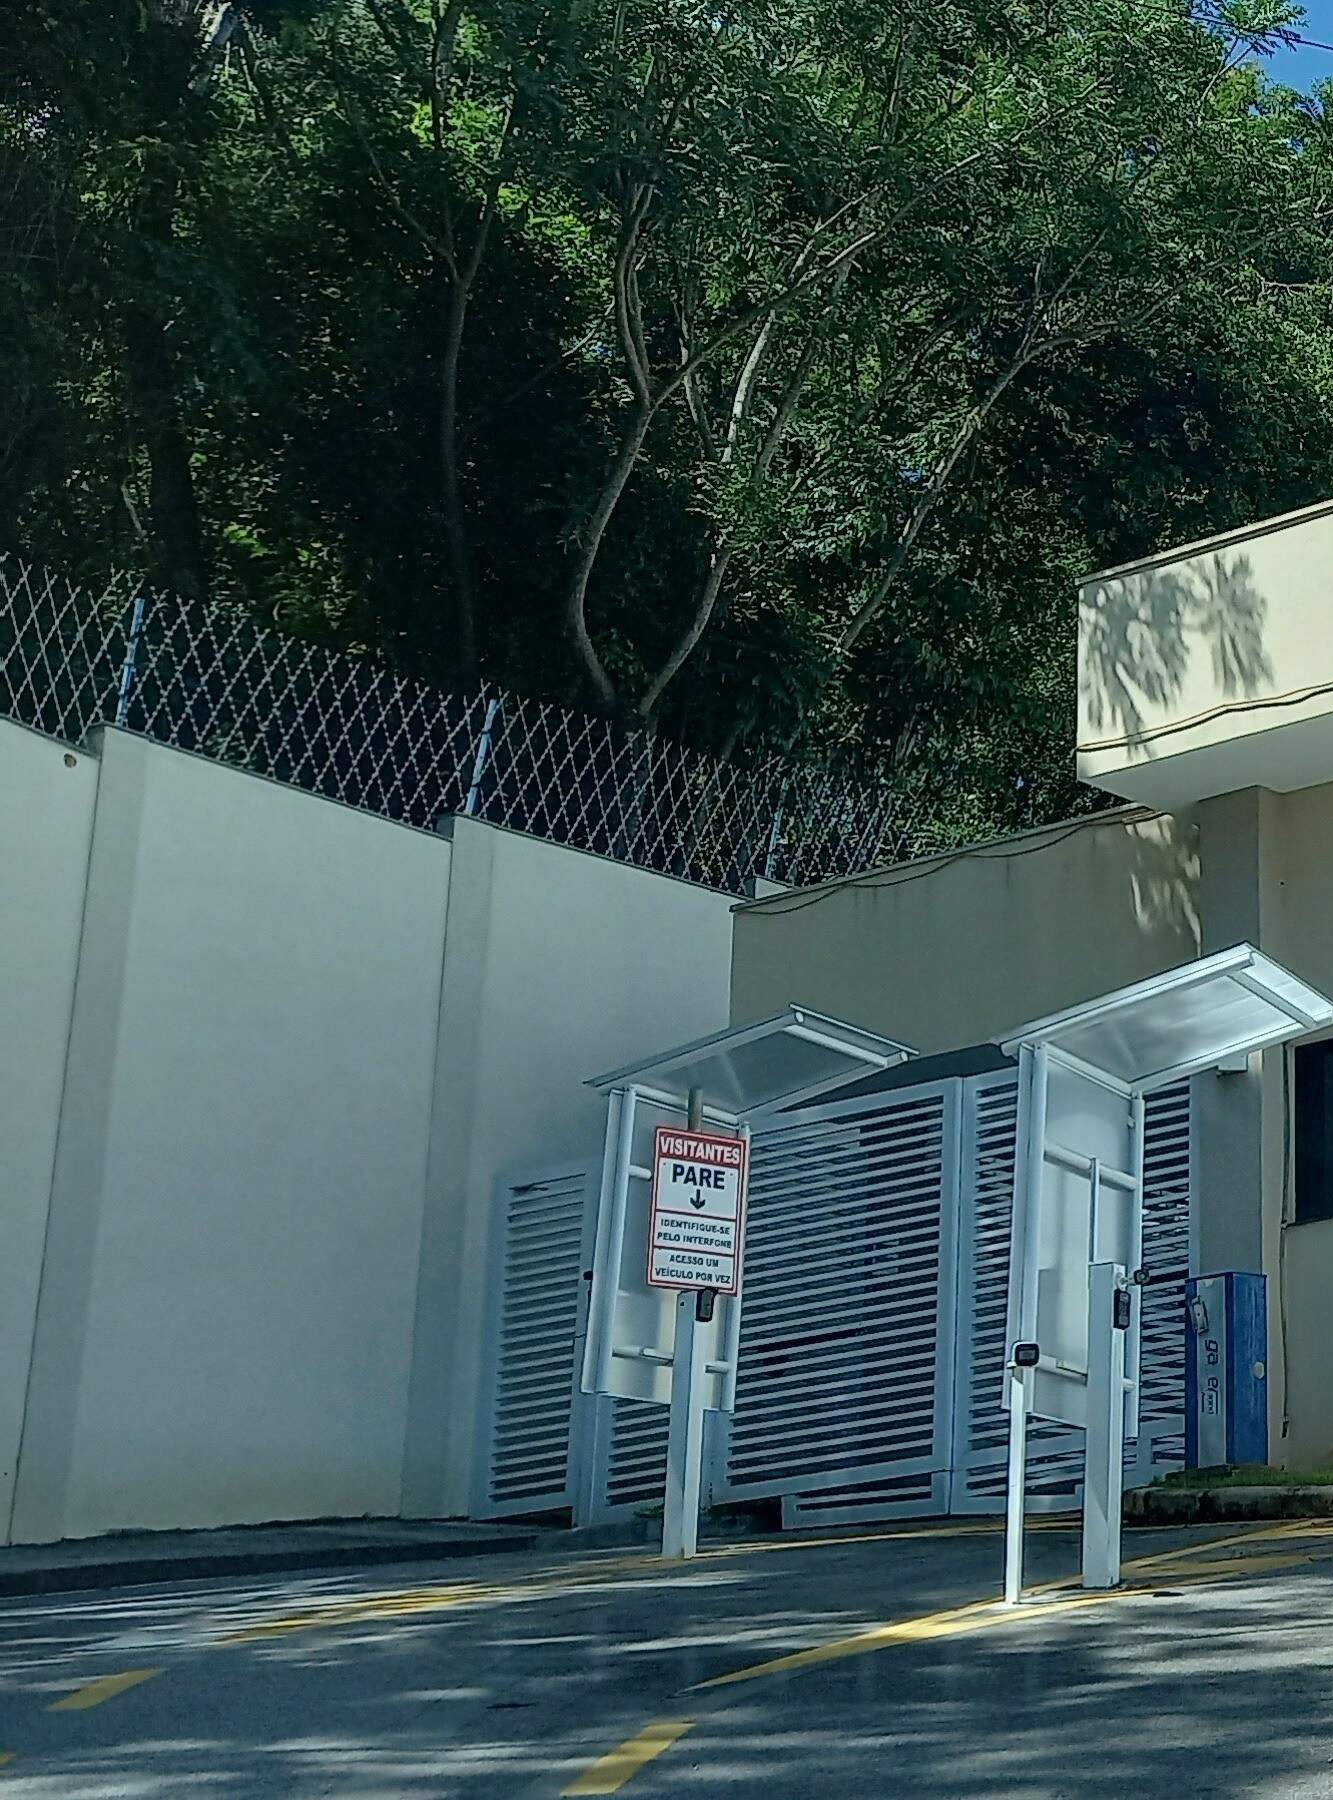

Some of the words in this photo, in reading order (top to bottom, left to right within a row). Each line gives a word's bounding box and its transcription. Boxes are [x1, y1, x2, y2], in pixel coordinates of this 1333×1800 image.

[660, 1136, 740, 1164] VISITANTES
[672, 1163, 726, 1190] PARE
[657, 1232, 681, 1242] PELO
[683, 1235, 732, 1249] INTERFONE
[669, 1254, 704, 1266] ACESSO
[706, 1258, 719, 1268] UM
[655, 1267, 693, 1280] VEÍCULO
[695, 1271, 713, 1282] POR
[715, 1274, 731, 1284] VEZ
